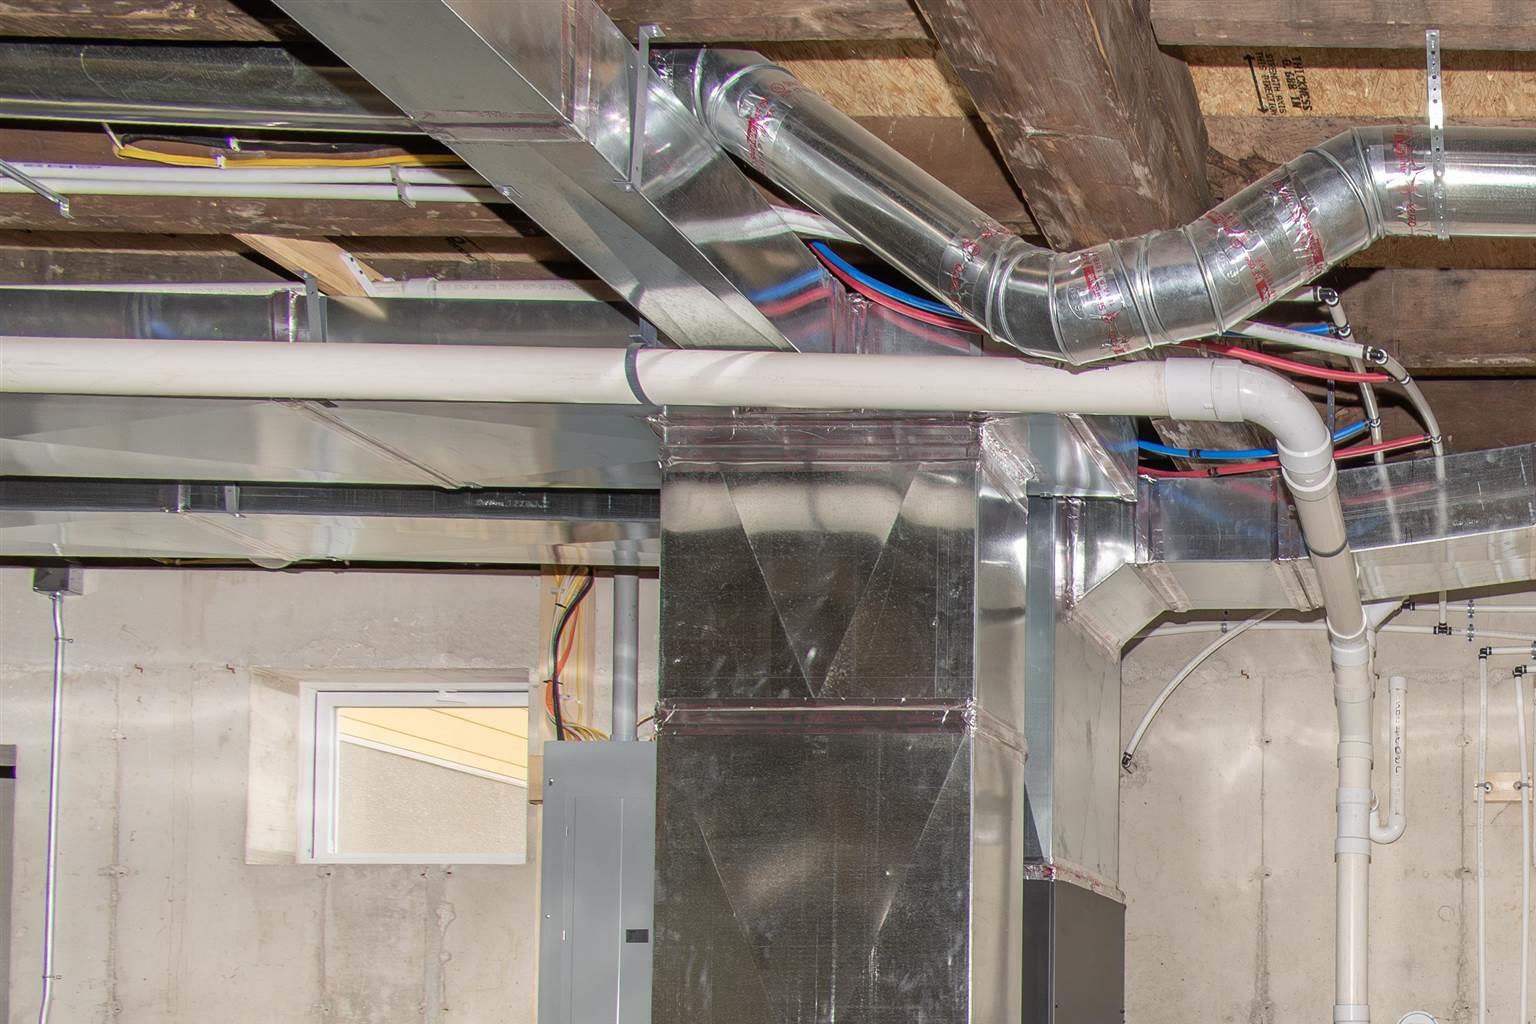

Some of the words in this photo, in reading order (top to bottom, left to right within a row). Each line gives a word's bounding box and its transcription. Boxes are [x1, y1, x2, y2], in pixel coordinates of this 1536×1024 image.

[1261, 75, 1277, 116] DIRECTION
[1265, 53, 1280, 92] STRENGTH
[1276, 95, 1286, 114] AXIS
[1292, 56, 1313, 111] THICKNESS
